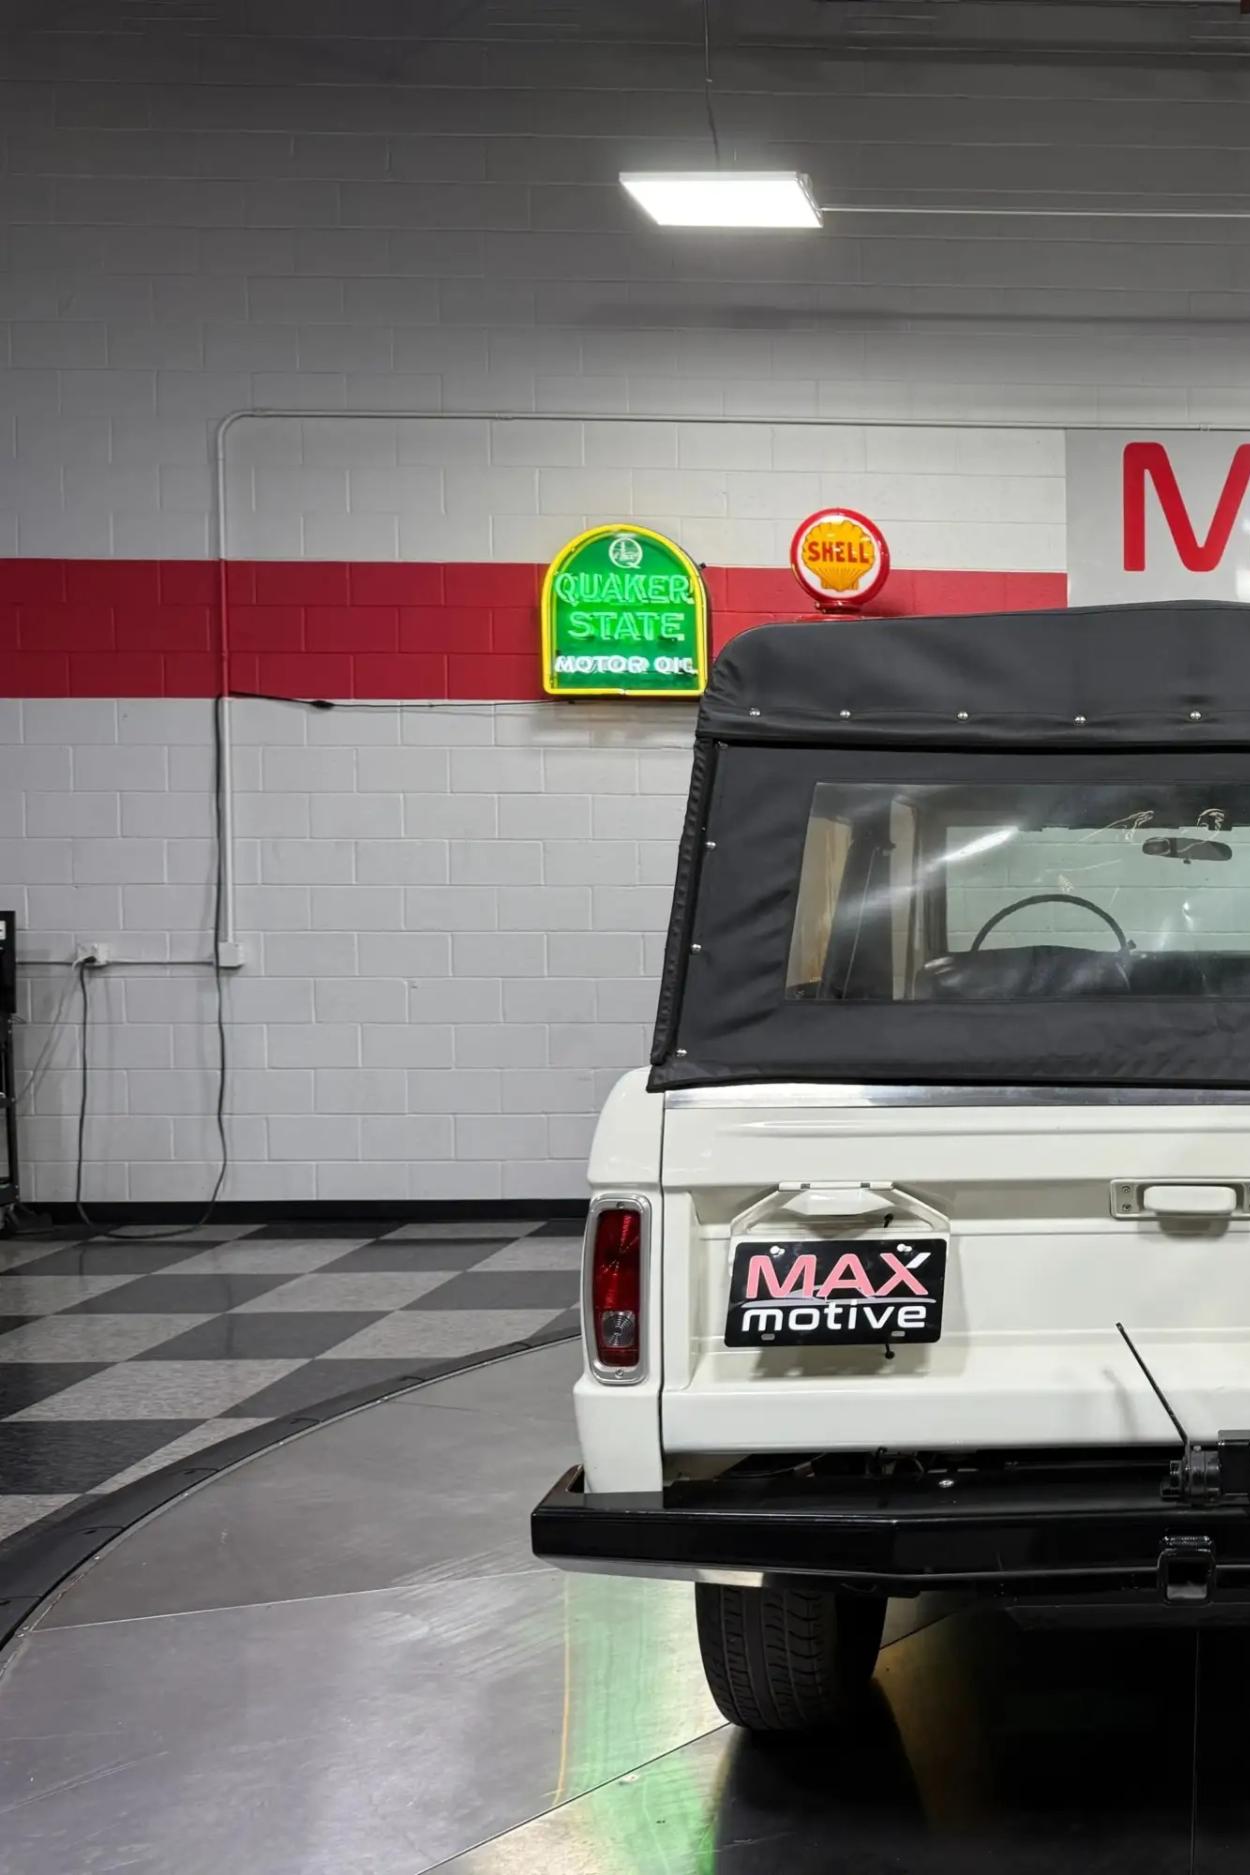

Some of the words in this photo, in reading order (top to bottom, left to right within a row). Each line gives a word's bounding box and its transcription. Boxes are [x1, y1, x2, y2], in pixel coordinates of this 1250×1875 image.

[807, 540, 870, 564] SHELL
[554, 572, 695, 607] QUAKER
[567, 611, 685, 641] STATE
[554, 654, 650, 674] MOTOR
[653, 655, 698, 675] OIL
[745, 1252, 931, 1299] MAX
[741, 1300, 927, 1332] motive
